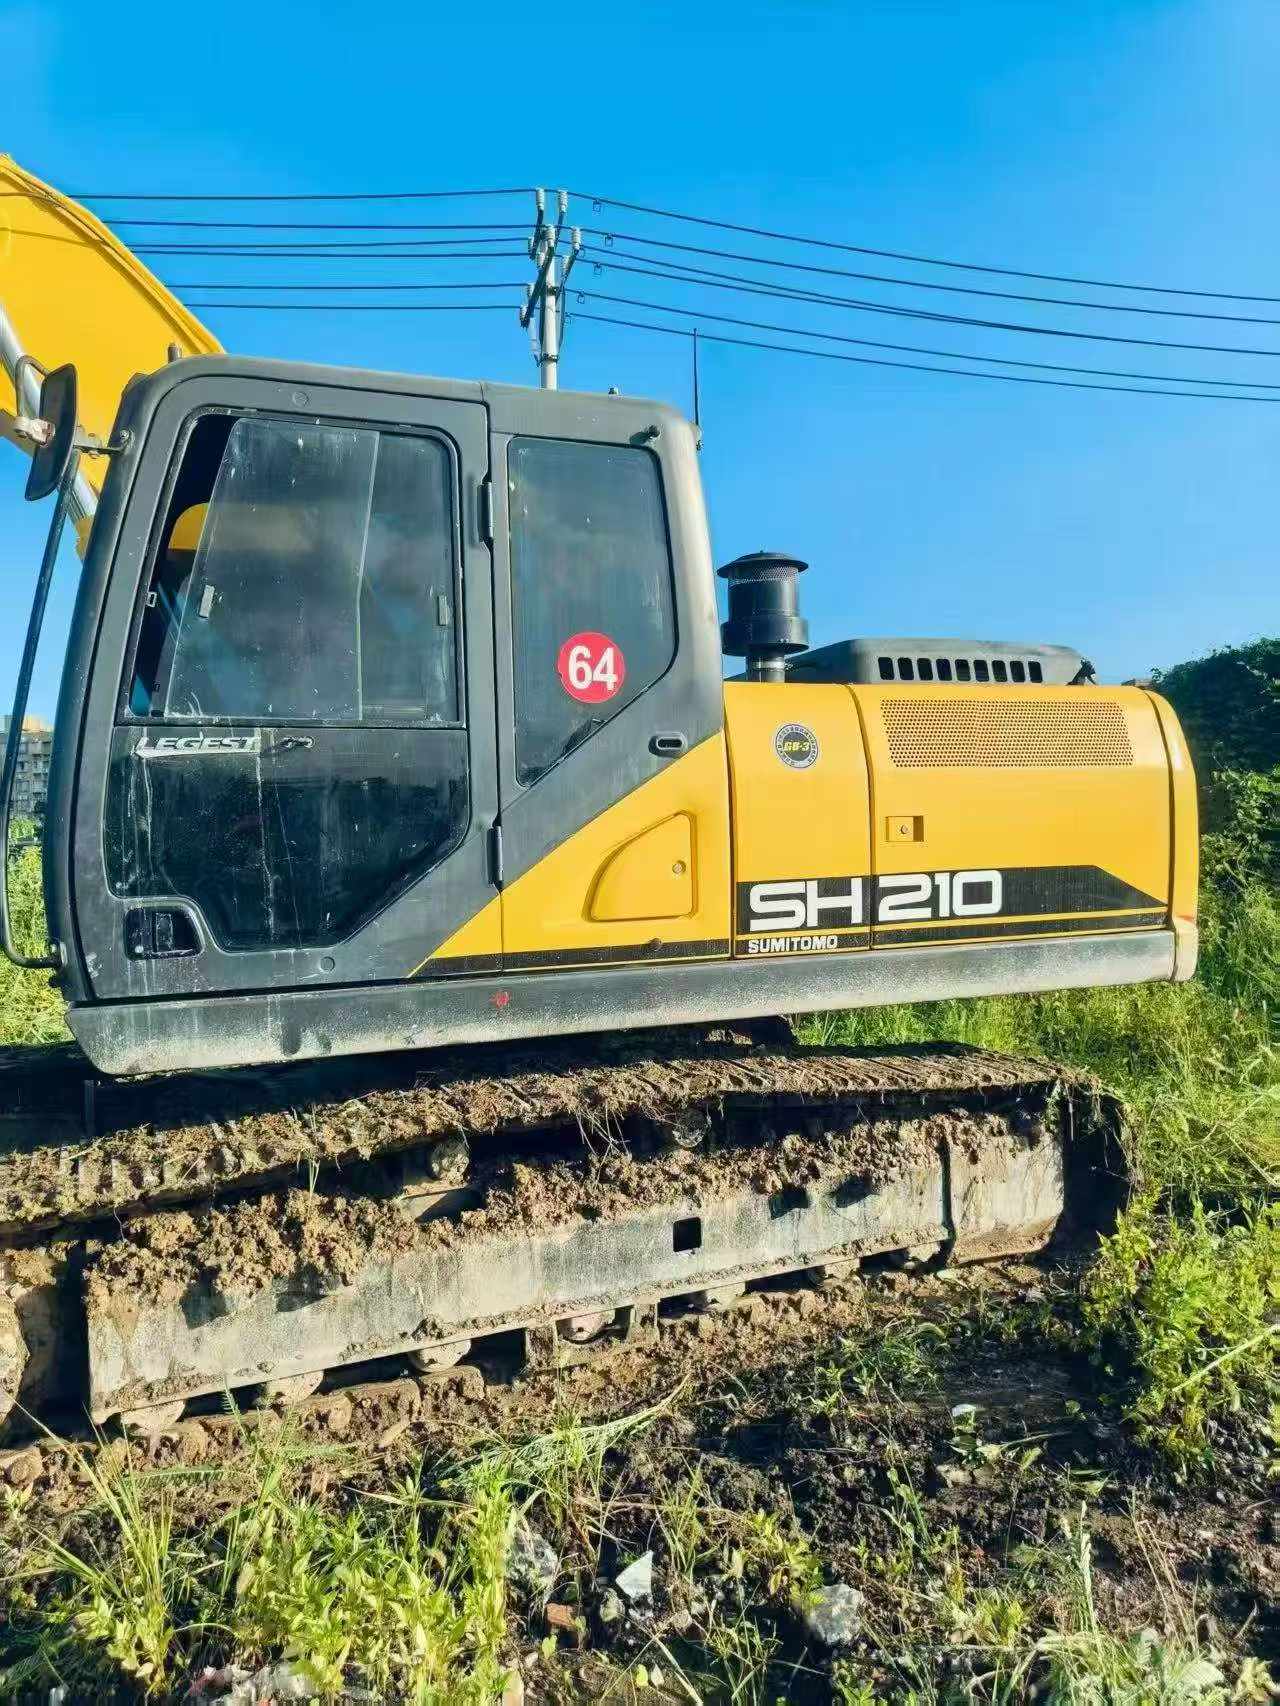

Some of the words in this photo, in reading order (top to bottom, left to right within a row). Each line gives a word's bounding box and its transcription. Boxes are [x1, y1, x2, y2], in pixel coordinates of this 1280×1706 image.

[568, 645, 618, 691] 64
[134, 734, 262, 758] LEGEST
[748, 936, 838, 954] SUMITOMO
